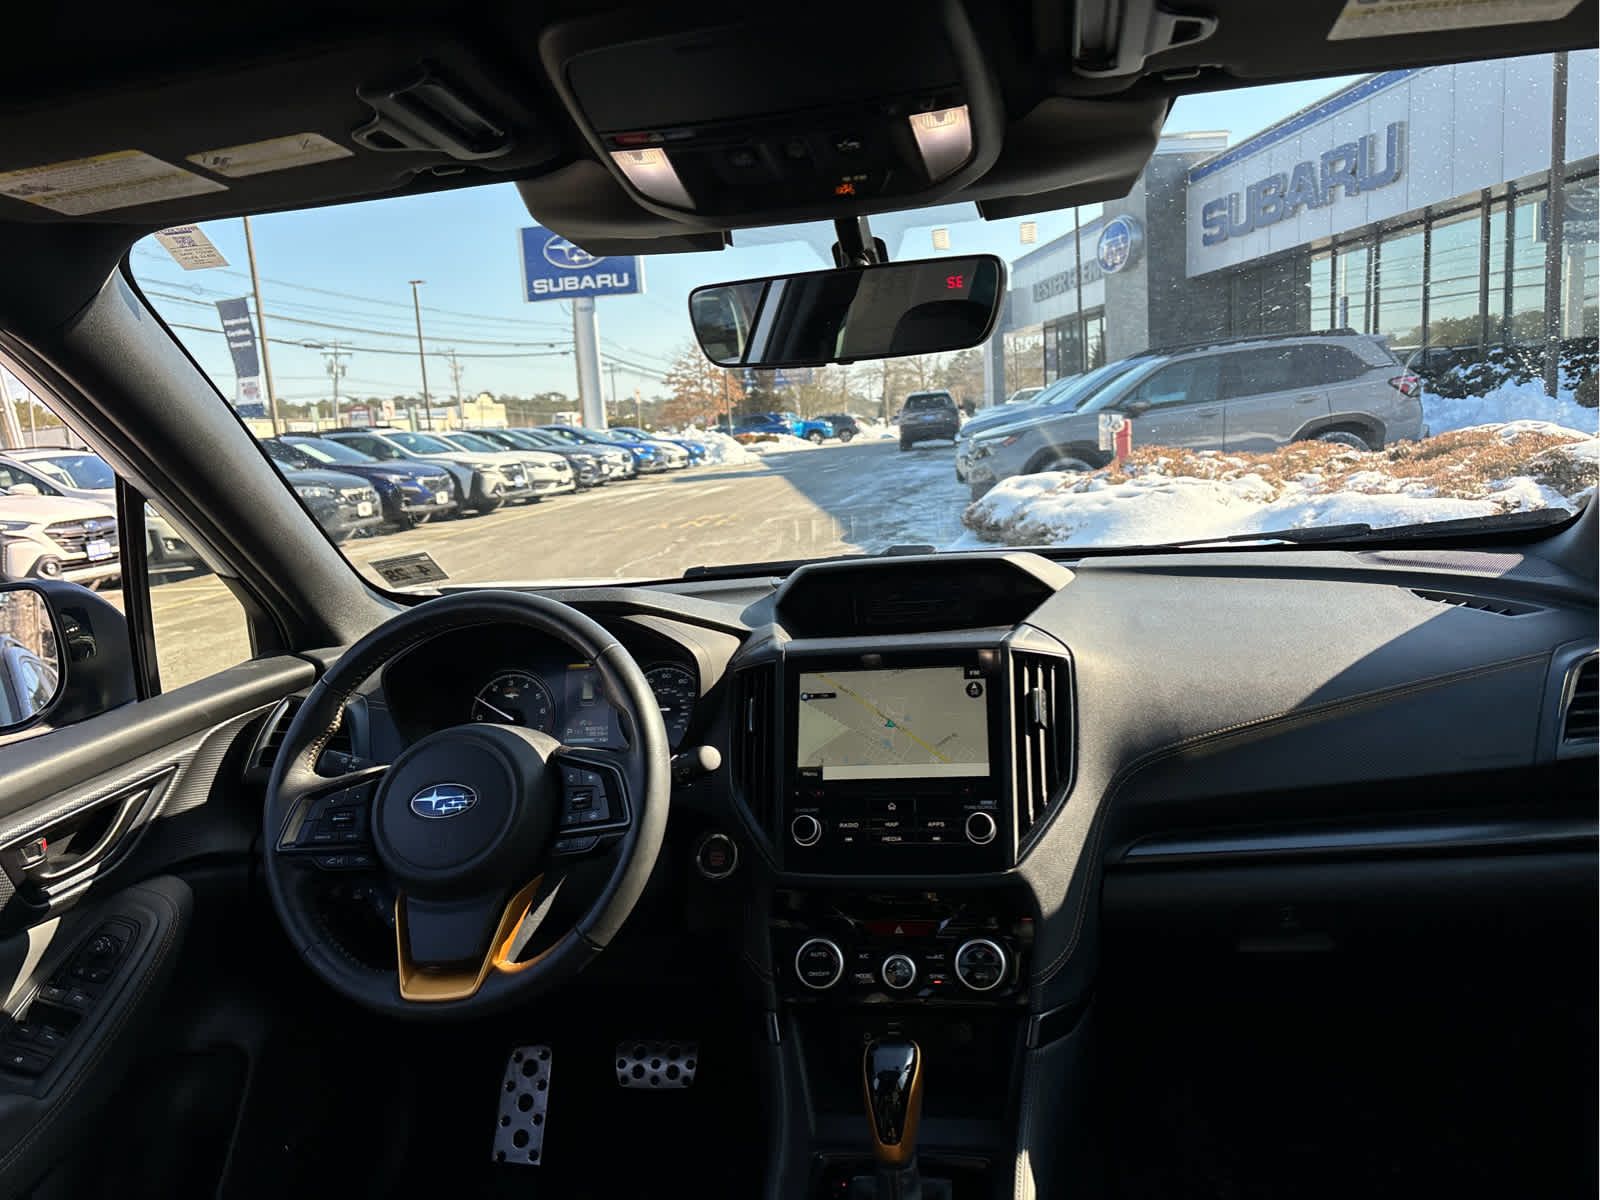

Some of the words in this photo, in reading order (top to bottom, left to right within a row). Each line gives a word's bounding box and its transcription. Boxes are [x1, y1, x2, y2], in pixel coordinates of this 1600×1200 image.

[1202, 121, 1407, 247] SUBARU
[533, 272, 629, 294] SUBARU
[946, 274, 963, 289] SE
